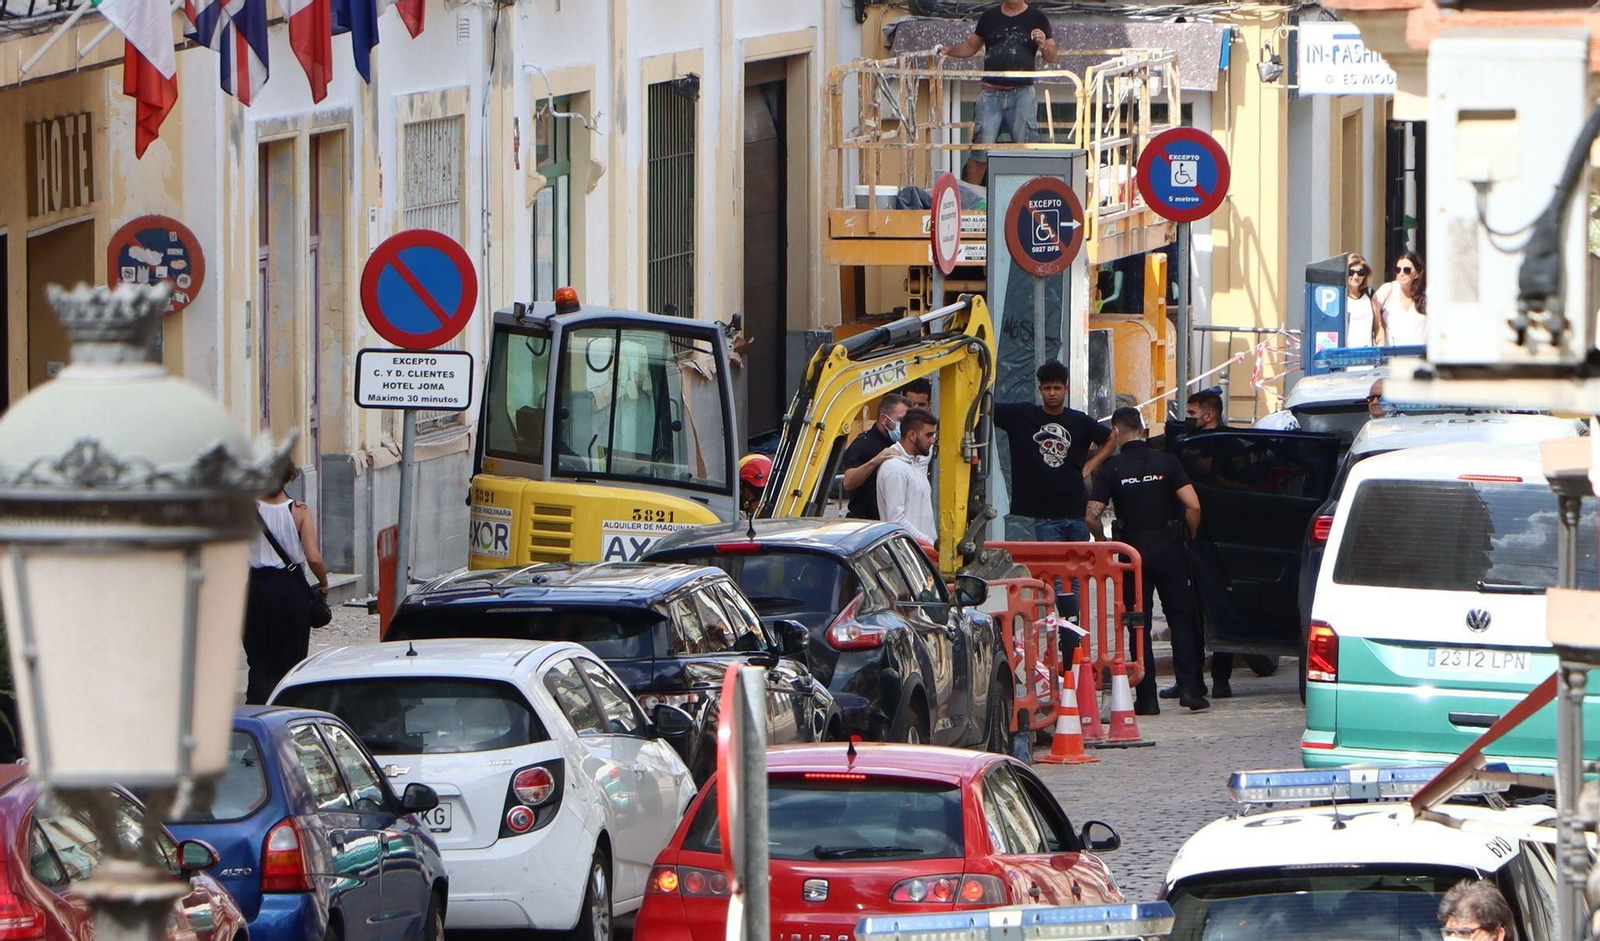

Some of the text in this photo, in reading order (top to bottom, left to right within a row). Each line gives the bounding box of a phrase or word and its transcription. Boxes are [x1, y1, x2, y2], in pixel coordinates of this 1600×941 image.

[1306, 44, 1384, 65] IN-FASHI
[1028, 199, 1062, 208] EXCEPTO
[392, 357, 437, 366] EXCEPTO
[373, 369, 383, 377] C.
[386, 369, 392, 377] Y
[407, 370, 455, 379] CLIENTES
[382, 382, 445, 391] HOTEL JOMA
[368, 394, 458, 404] Máximo 30 minutos
[1121, 474, 1159, 485] POLCIA
[632, 508, 674, 523] 3821
[603, 521, 641, 530] ALQUILER
[643, 523, 653, 531] DE
[604, 536, 652, 562] AX
[1440, 650, 1526, 669] 2312 LPN
[417, 807, 445, 825] KG
[220, 867, 252, 876] ALTO
